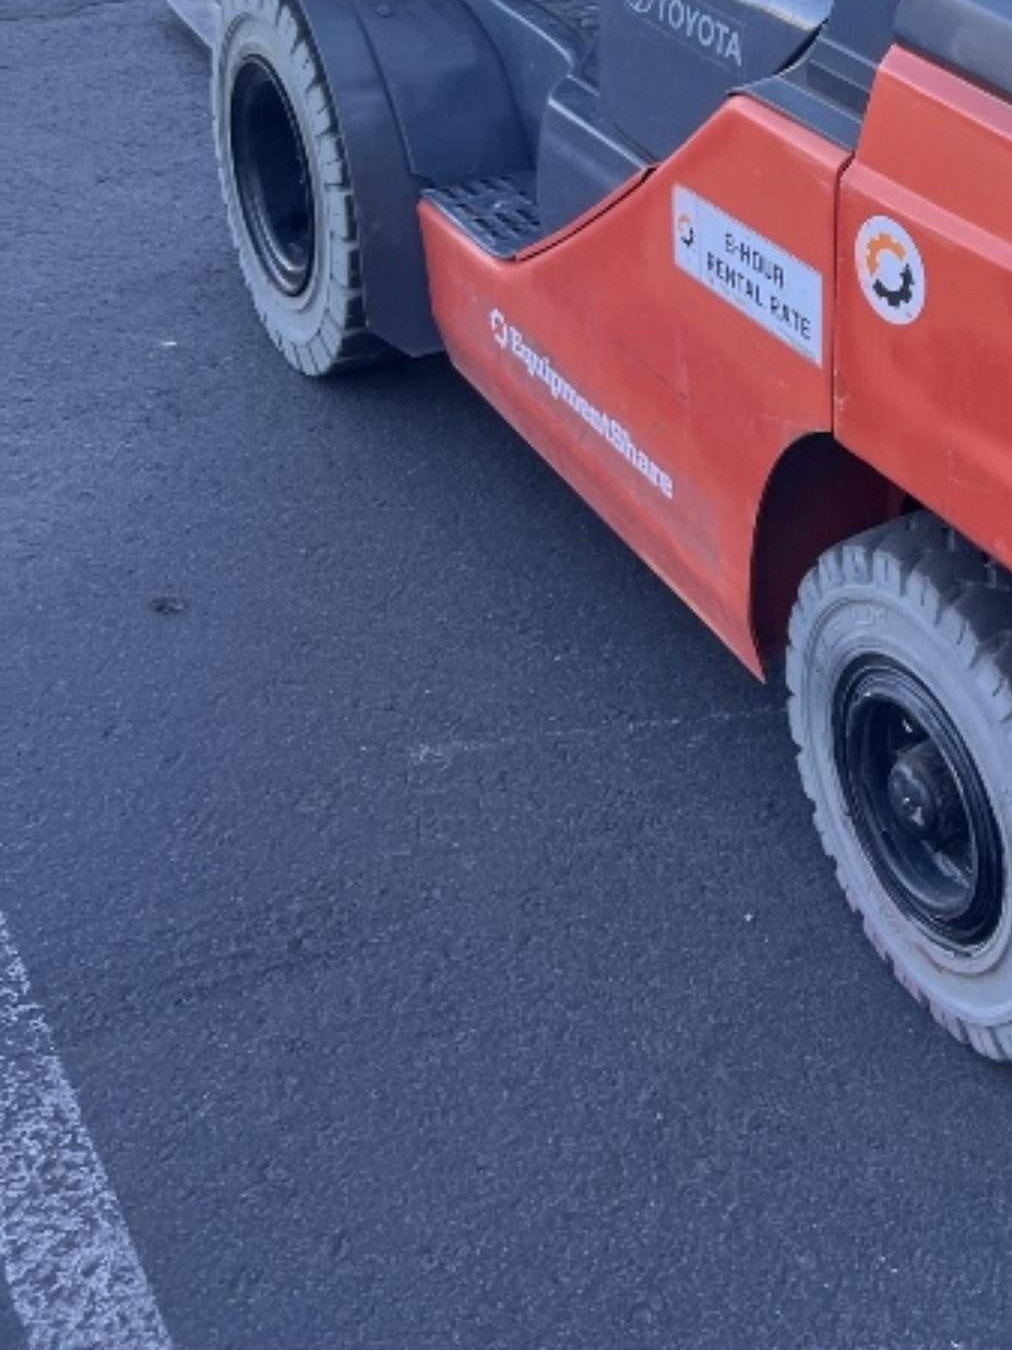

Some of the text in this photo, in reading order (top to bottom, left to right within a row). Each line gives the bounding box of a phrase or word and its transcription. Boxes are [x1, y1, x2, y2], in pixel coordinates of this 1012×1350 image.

[706, 251, 812, 340] RENTAL RATE
[509, 325, 674, 500] EquipmentShare
